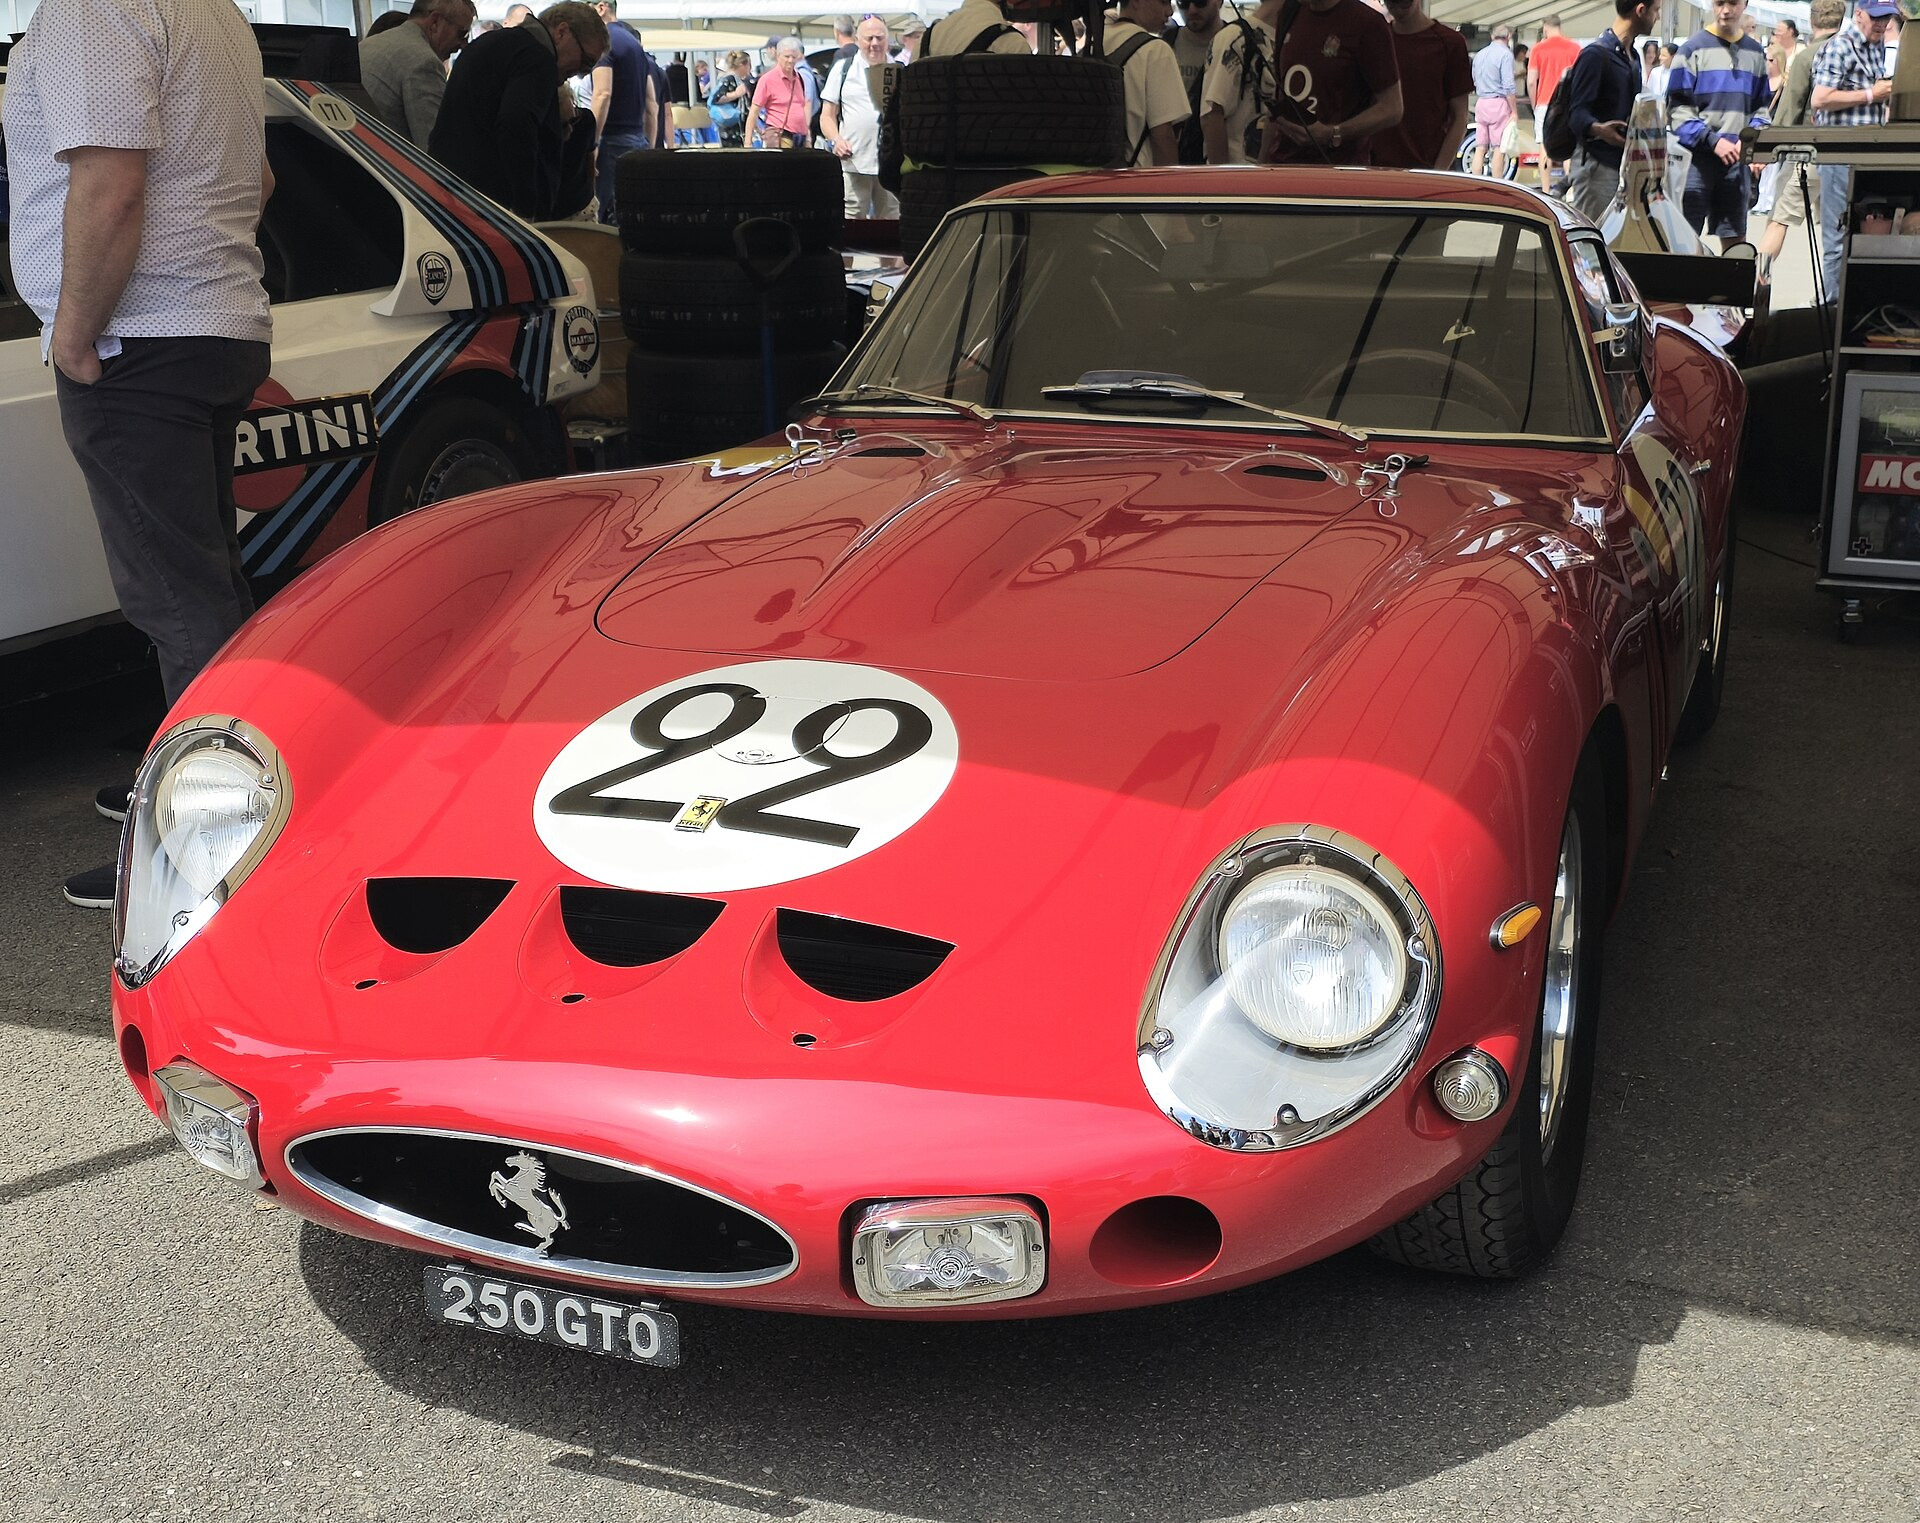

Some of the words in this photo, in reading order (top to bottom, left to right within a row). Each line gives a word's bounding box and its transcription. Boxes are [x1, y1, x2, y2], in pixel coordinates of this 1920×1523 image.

[549, 683, 932, 848] 22
[442, 1277, 545, 1335] 250
[555, 1298, 660, 1358] GTO
